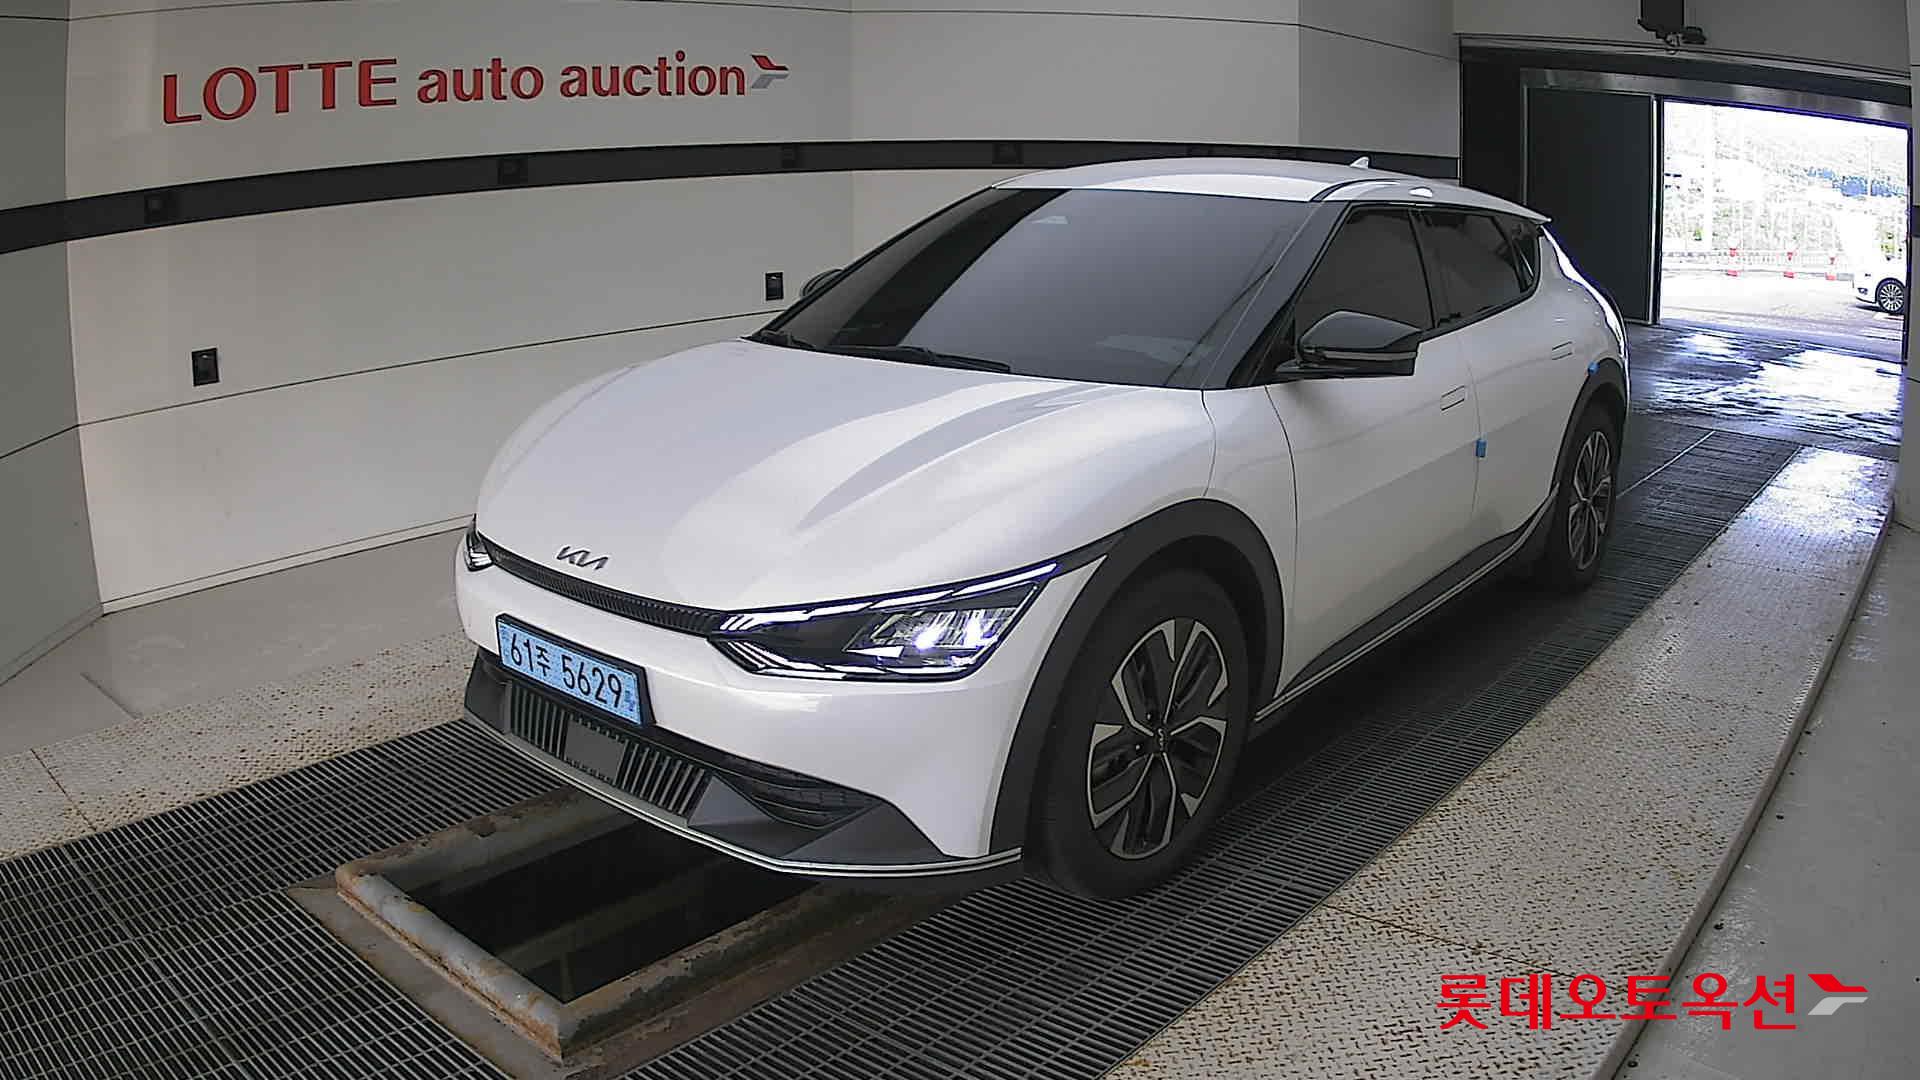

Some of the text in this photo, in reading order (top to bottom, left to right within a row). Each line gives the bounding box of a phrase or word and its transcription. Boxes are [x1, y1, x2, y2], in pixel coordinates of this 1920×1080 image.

[163, 49, 747, 125] LOTTE auto auction
[556, 545, 608, 570] KIA
[510, 632, 622, 708] 61주 5629
